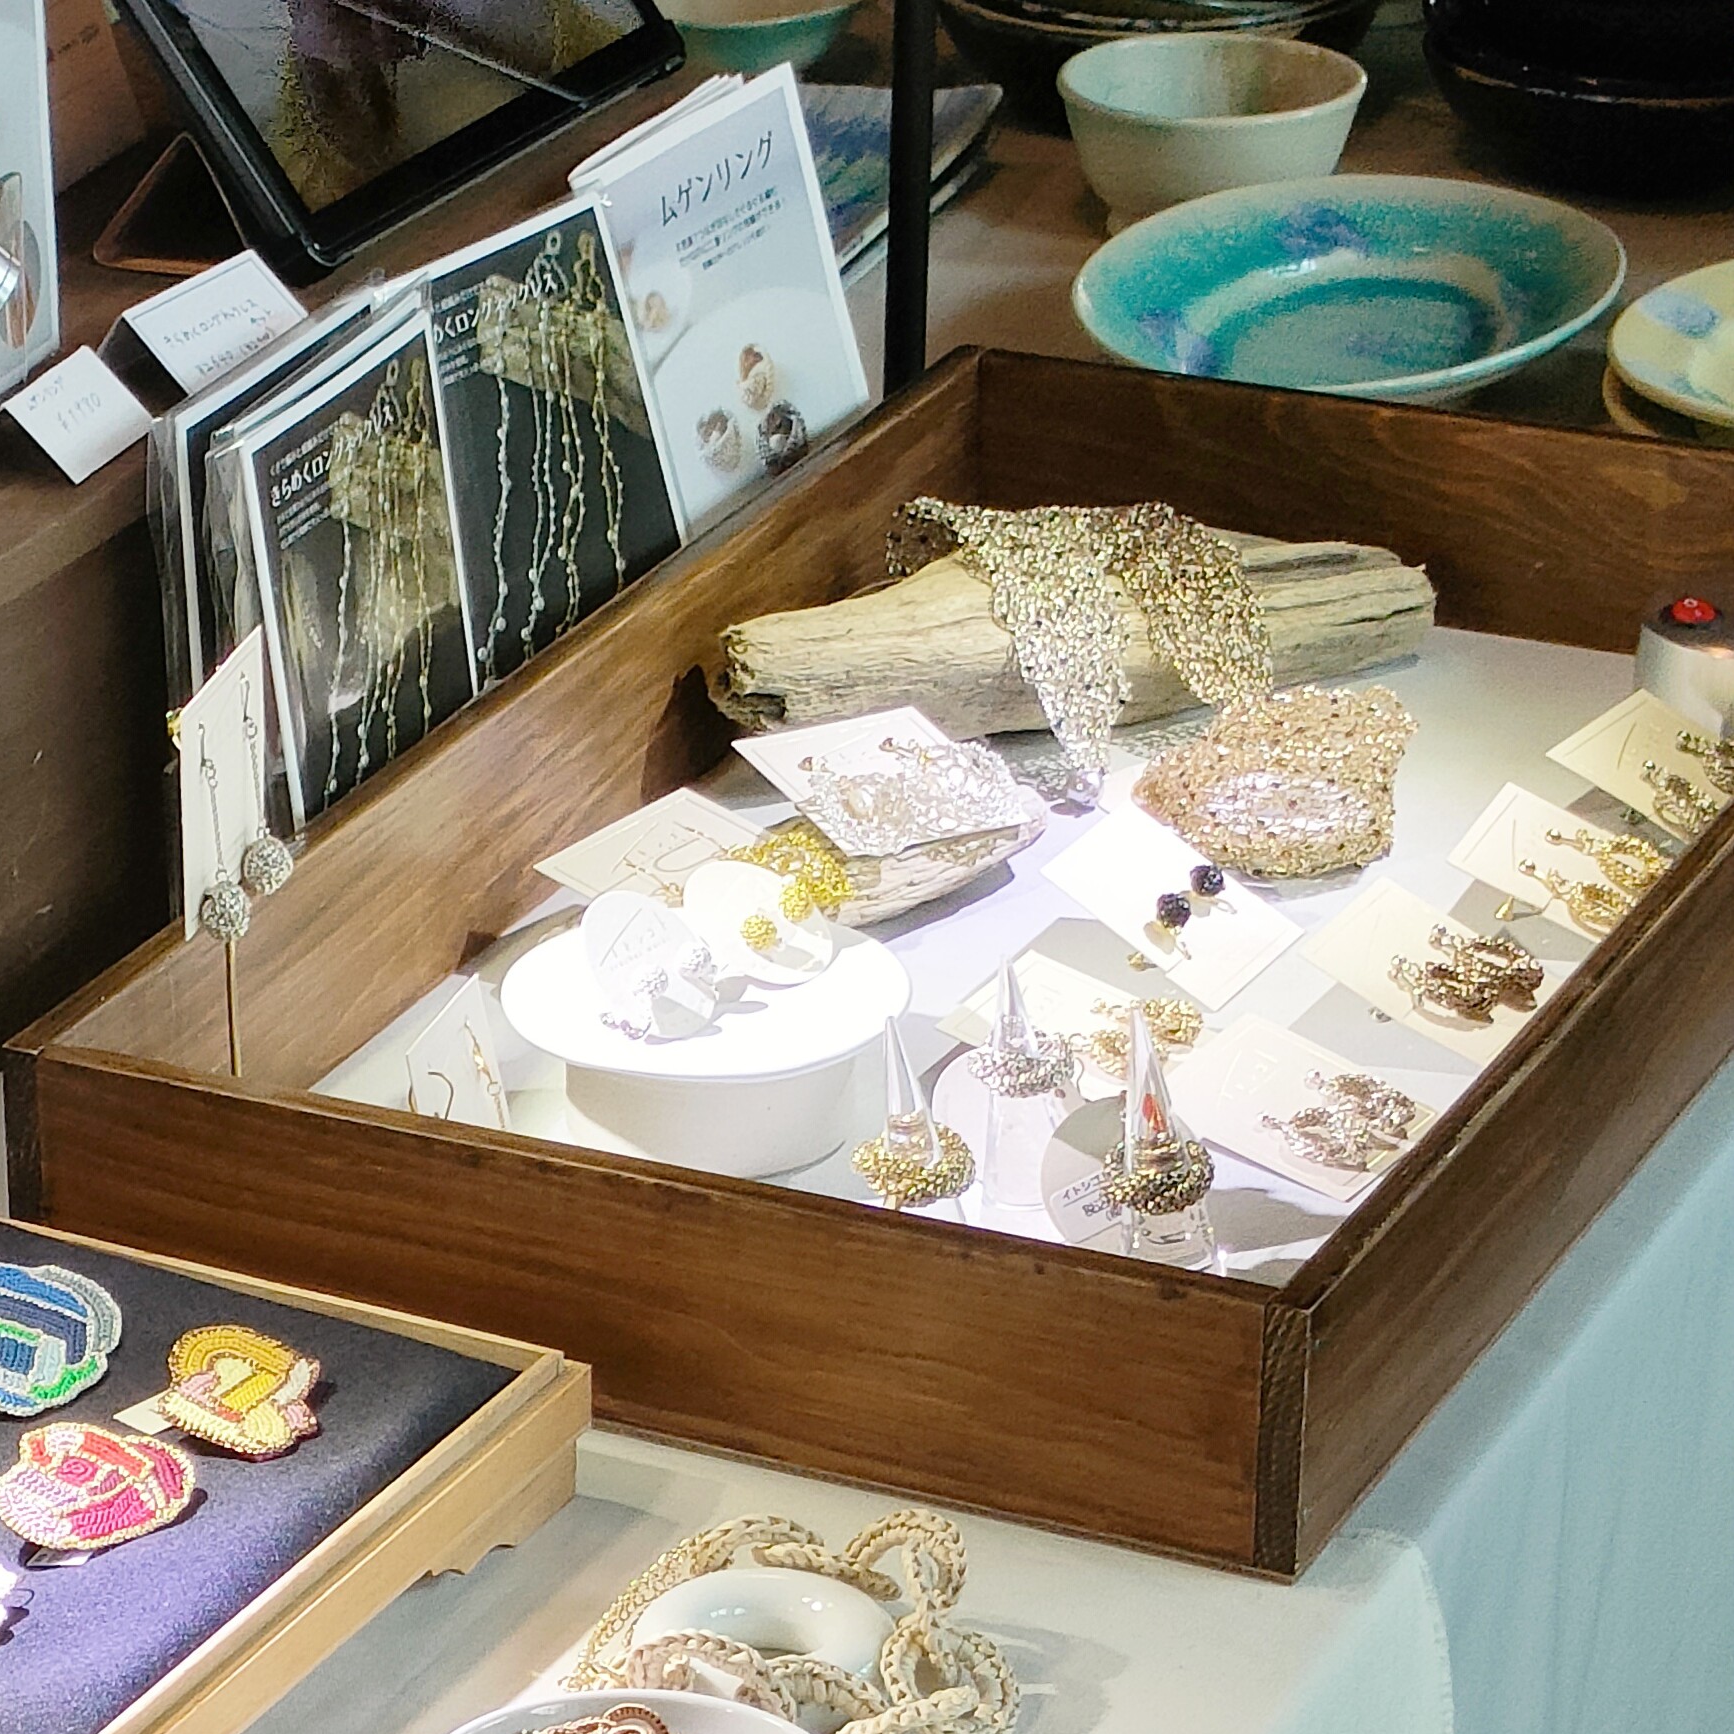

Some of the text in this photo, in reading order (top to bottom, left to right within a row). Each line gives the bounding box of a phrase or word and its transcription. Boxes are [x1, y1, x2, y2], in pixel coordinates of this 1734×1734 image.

[662, 130, 772, 227] ムゲンリング
